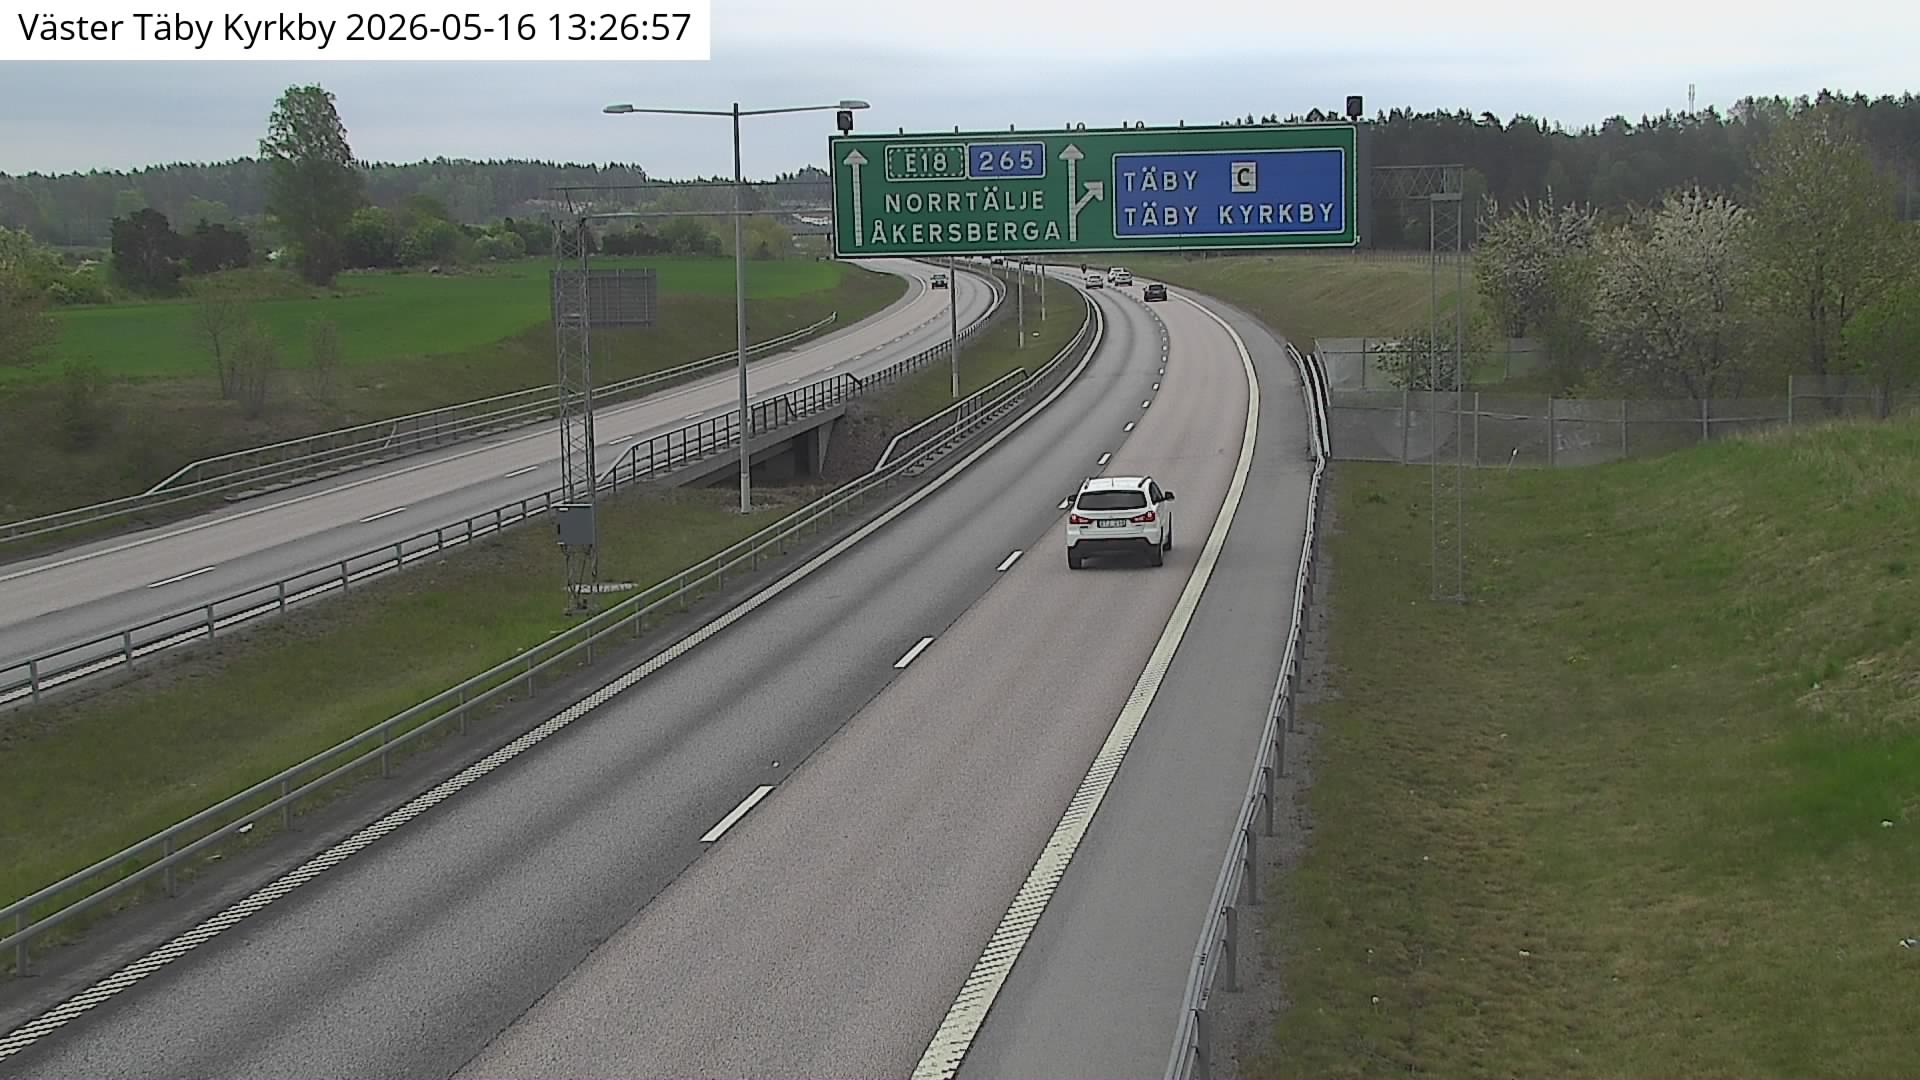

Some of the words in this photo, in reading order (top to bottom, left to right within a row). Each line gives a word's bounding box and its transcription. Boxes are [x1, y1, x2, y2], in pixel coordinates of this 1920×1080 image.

[905, 153, 948, 173] E18
[979, 151, 1034, 171] 265
[1123, 166, 1198, 192] TÄBY
[1237, 167, 1251, 187] C
[885, 186, 1044, 213] NORRTÄLJE
[1124, 201, 1198, 226] TÄBY
[1219, 204, 1333, 225] KYRKBY
[871, 219, 1061, 244] ÅKERSBERGA
